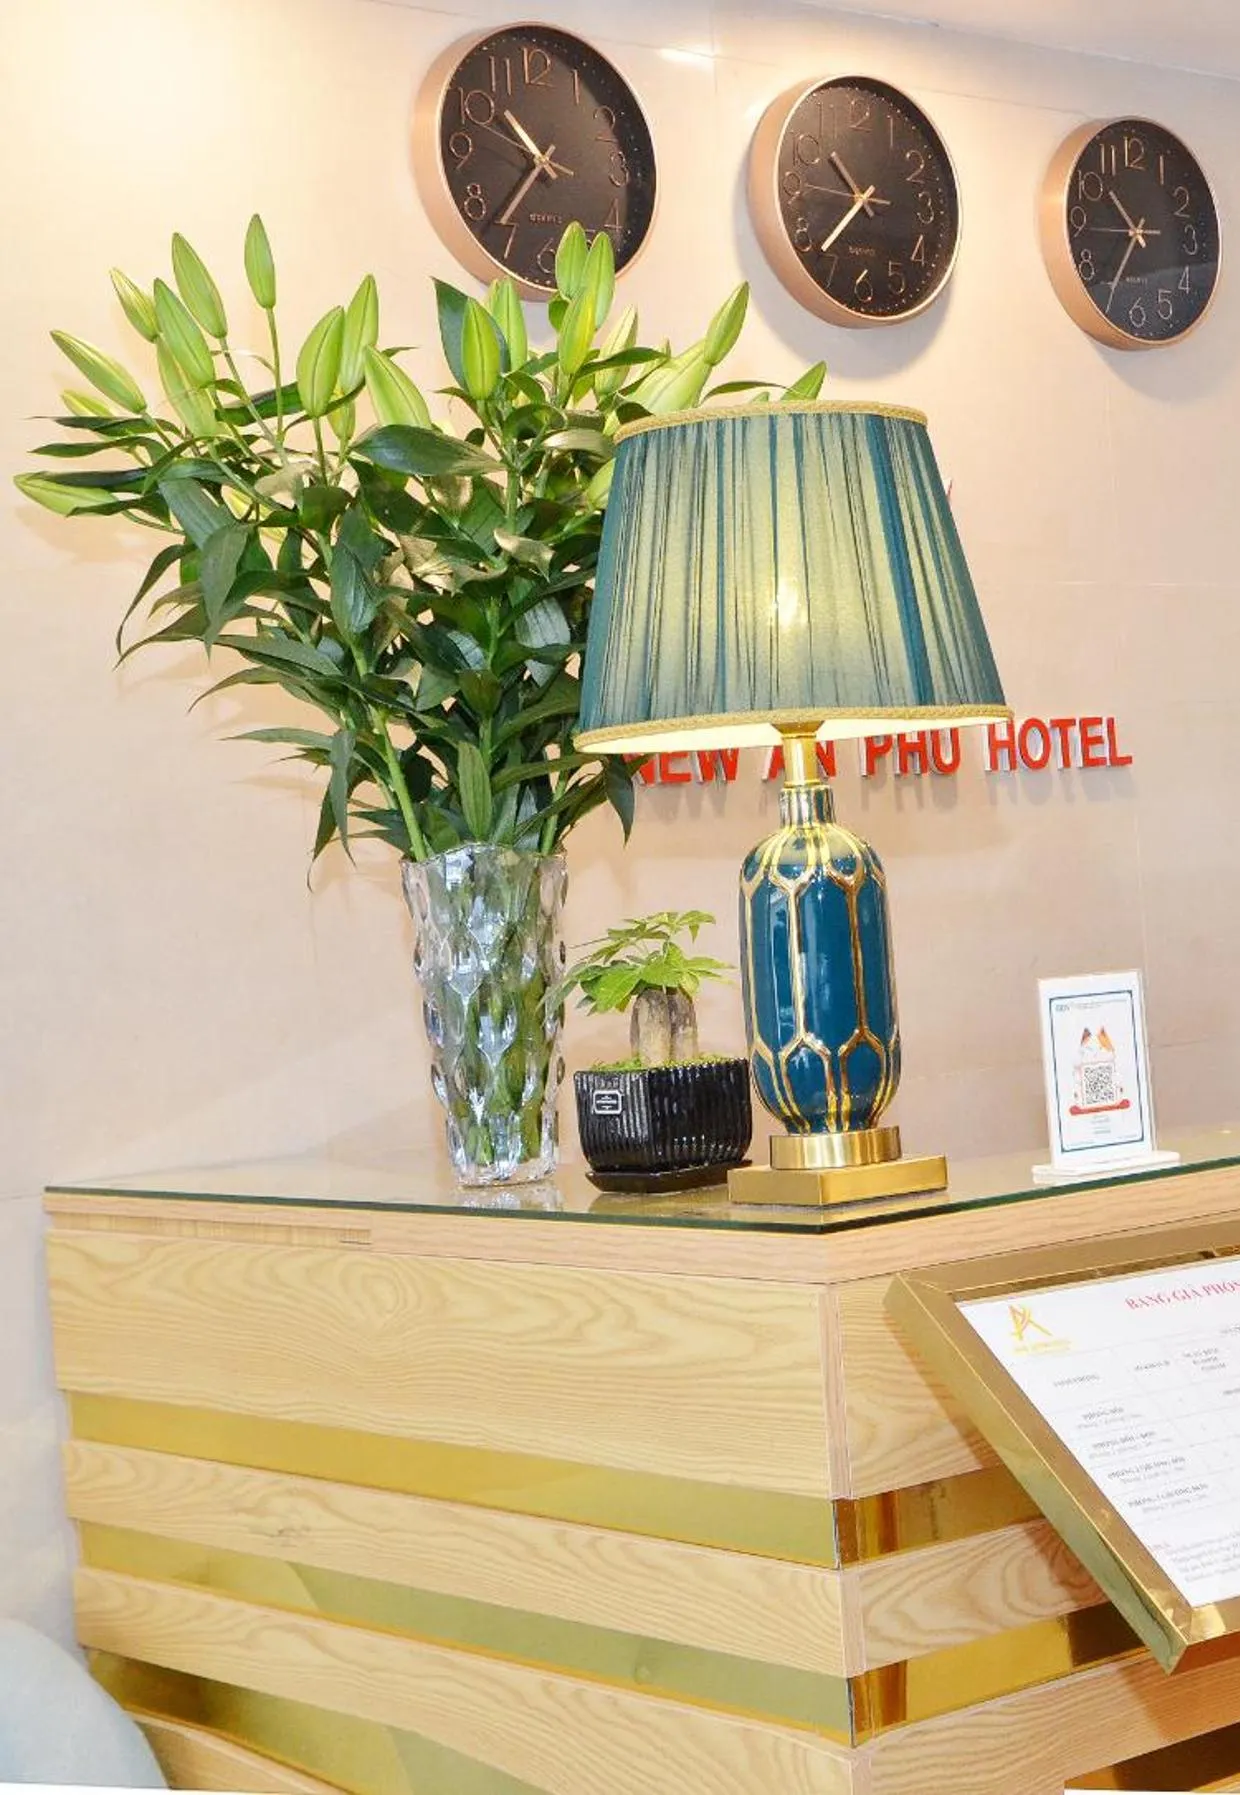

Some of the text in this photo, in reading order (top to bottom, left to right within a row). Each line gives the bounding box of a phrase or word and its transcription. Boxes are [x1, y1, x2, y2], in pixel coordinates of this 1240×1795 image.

[489, 54, 512, 95] 11
[523, 47, 553, 87] 12
[572, 68, 580, 105] 1
[458, 87, 495, 125] 10
[593, 104, 619, 144] 2
[886, 114, 894, 148] 1
[450, 132, 472, 170] 9
[790, 130, 821, 167] 10
[1100, 142, 1116, 177] 11
[1123, 135, 1145, 171] 12
[609, 150, 629, 187] 3
[906, 149, 925, 184] 2
[1158, 153, 1165, 185] 1
[464, 183, 487, 220] 8
[782, 170, 802, 205] 9
[1077, 169, 1103, 201] 10
[1172, 185, 1190, 218] 2
[917, 190, 934, 225] 3
[1070, 206, 1087, 238] 9
[494, 219, 519, 259] 7
[794, 217, 812, 252] 8
[911, 234, 925, 267] 4
[1182, 223, 1198, 256] 3
[821, 251, 839, 291] 7
[887, 260, 906, 295] 5
[1078, 248, 1095, 281] 8
[1177, 265, 1190, 294] 4
[854, 268, 873, 302] 6
[1129, 296, 1147, 328] 6
[1157, 289, 1172, 320] 5
[984, 717, 1132, 771] HOTEL
